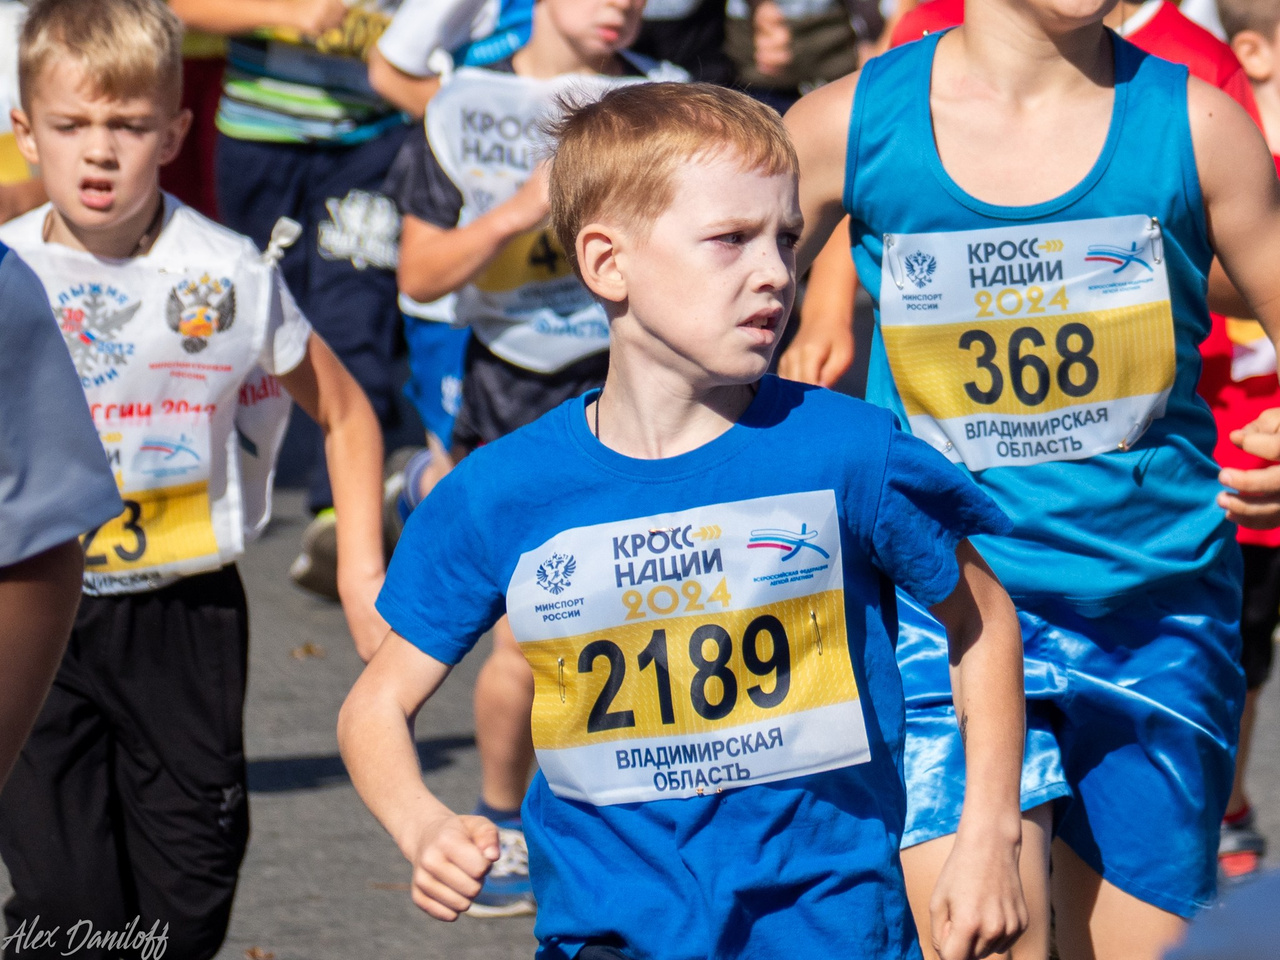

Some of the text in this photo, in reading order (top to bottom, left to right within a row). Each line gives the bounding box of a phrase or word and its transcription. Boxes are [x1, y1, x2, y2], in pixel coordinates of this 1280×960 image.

[967, 238, 1040, 264] КРОСС
[969, 260, 1064, 289] НАЦИИ
[902, 293, 943, 303] МИНСПОРТ
[906, 303, 939, 312] РОССИИ
[974, 285, 1070, 318] 2024
[958, 322, 1099, 406] 368
[965, 407, 1109, 441] ВЛАДИМИРСКАЯ
[996, 436, 1083, 458] ОБЛАСТЬ
[612, 524, 695, 560] КРОСС
[615, 547, 724, 588] НАЦИИ
[534, 597, 585, 613] МИНСПОРТ
[621, 576, 732, 622] 2024
[542, 609, 581, 623] РОССИИ
[577, 615, 791, 734] 2189
[616, 727, 784, 770] ВЛАДИМИРСКАЯ
[653, 762, 751, 792] ОБЛАСТЬ
